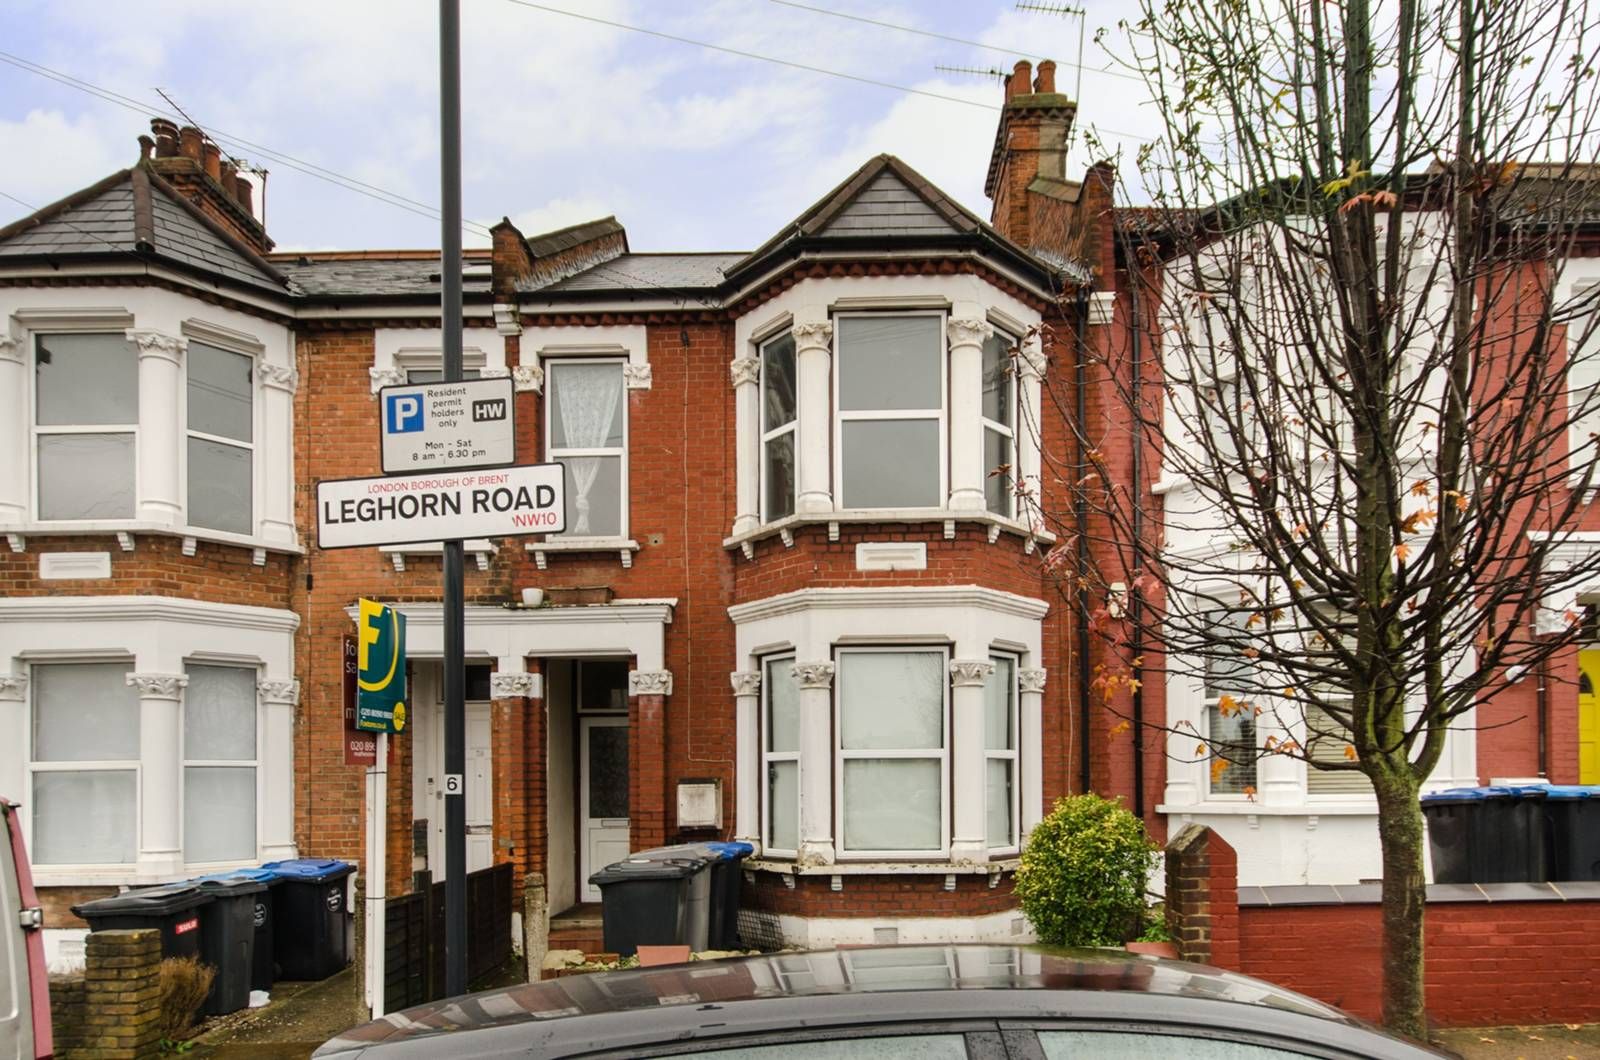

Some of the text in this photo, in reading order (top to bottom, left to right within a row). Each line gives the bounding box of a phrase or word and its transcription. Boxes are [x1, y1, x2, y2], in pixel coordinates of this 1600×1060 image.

[427, 387, 467, 398] Resident
[432, 399, 462, 409] permit
[395, 397, 419, 431] P
[431, 408, 465, 418] holders
[475, 403, 504, 419] HW
[438, 419, 458, 428] only
[425, 441, 444, 450] Mon
[456, 439, 472, 448] Sat
[412, 453, 418, 461] 8
[447, 449, 469, 459] 6.30
[472, 449, 487, 458] pm
[368, 474, 510, 494] LONDON BOROUGH OF BRENT
[324, 484, 556, 525] LEGHORN ROAD
[515, 512, 557, 527] NW10
[350, 741, 364, 751] 020
[446, 776, 458, 791] 6
